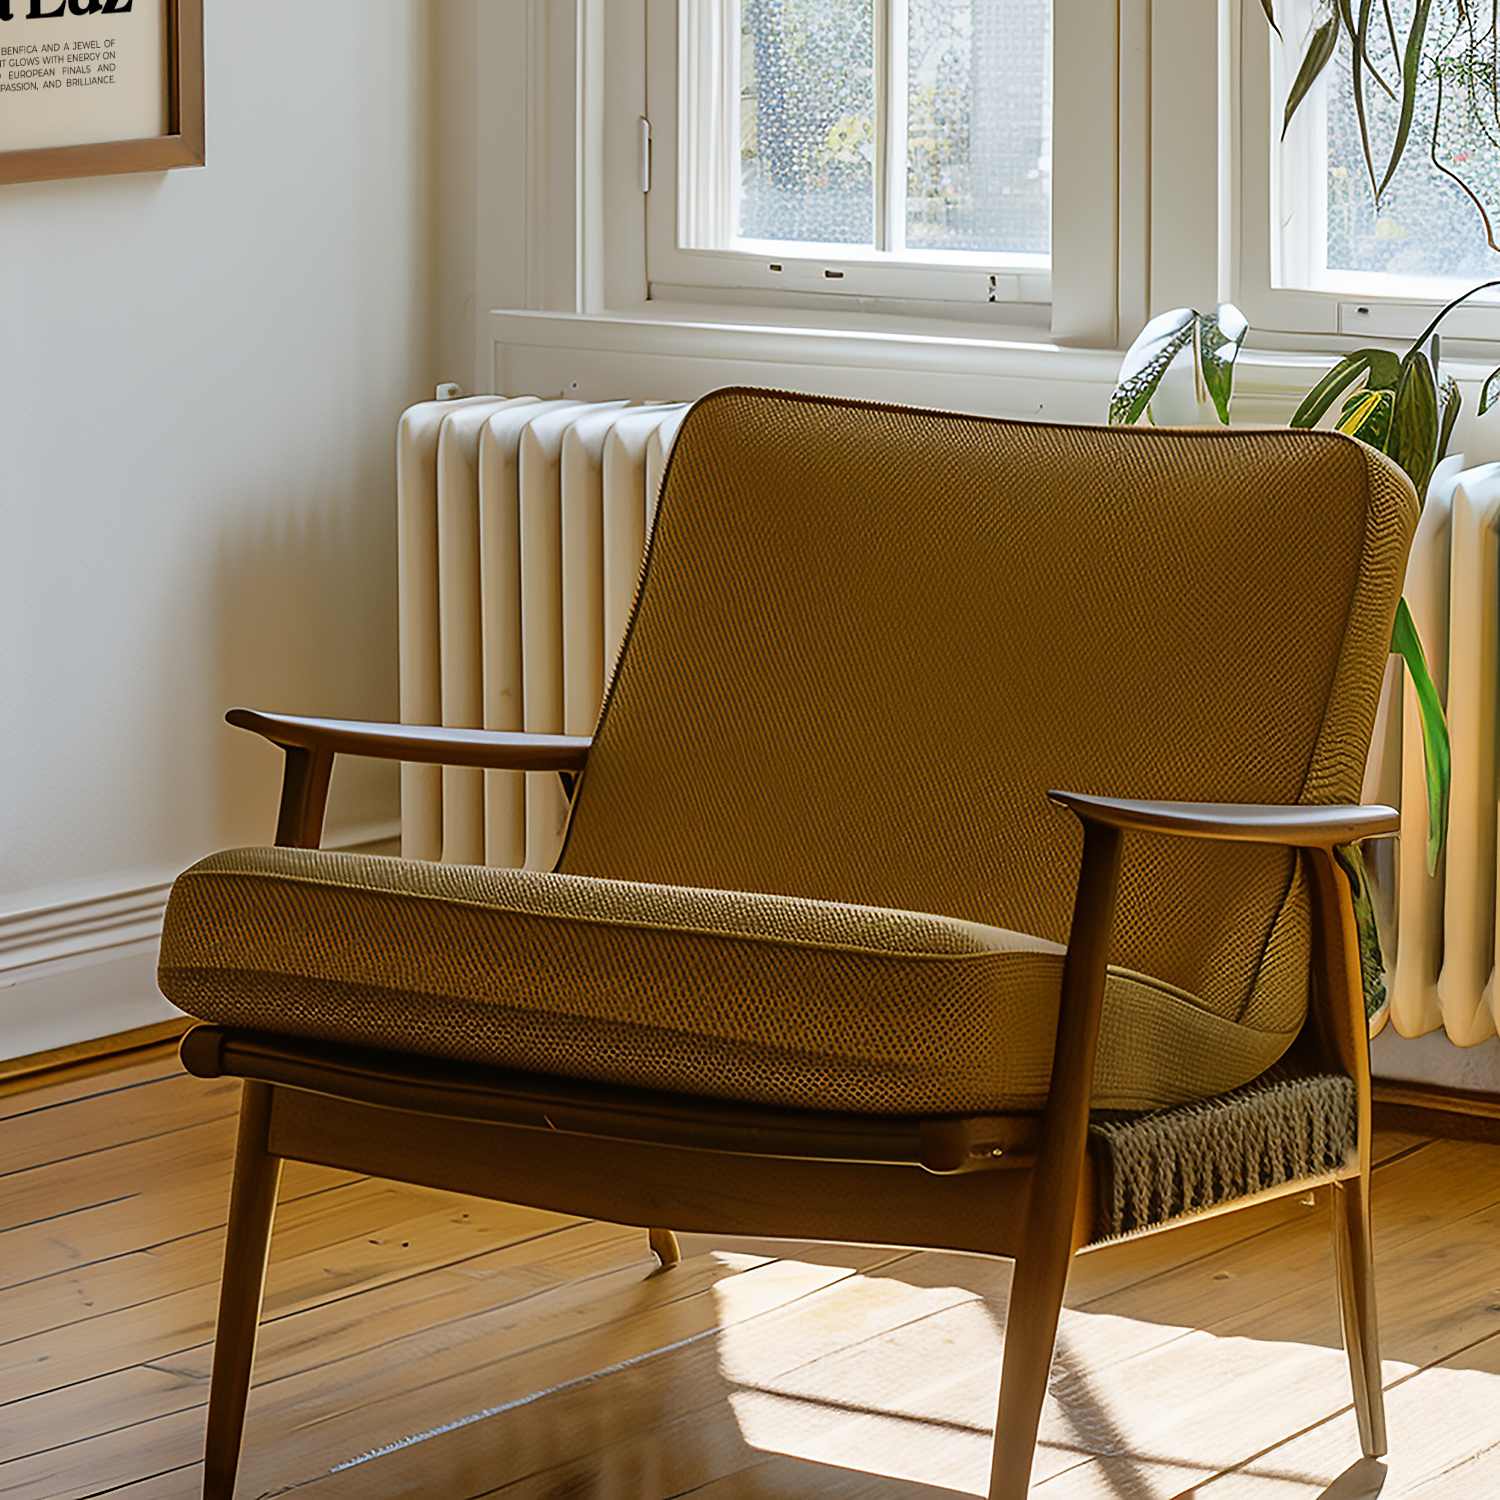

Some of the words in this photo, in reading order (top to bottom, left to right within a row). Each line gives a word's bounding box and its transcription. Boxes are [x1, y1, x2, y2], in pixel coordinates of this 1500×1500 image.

[0, 45, 38, 56] BENFICA
[40, 43, 61, 53] AND
[63, 43, 70, 51] A
[72, 41, 102, 51] JEWEL
[103, 39, 116, 49] OF
[0, 59, 7, 69] IT
[8, 57, 41, 68] GLOWS
[41, 55, 65, 65] WITH
[66, 52, 101, 63] ENERGY
[102, 51, 116, 61] ON
[8, 68, 56, 80] EUROPEAN
[62, 65, 92, 76] FINALS
[96, 63, 117, 73] AND
[0, 82, 39, 93] PASSION,
[42, 80, 63, 90] AND
[66, 75, 116, 88] BRILLIANCE.
